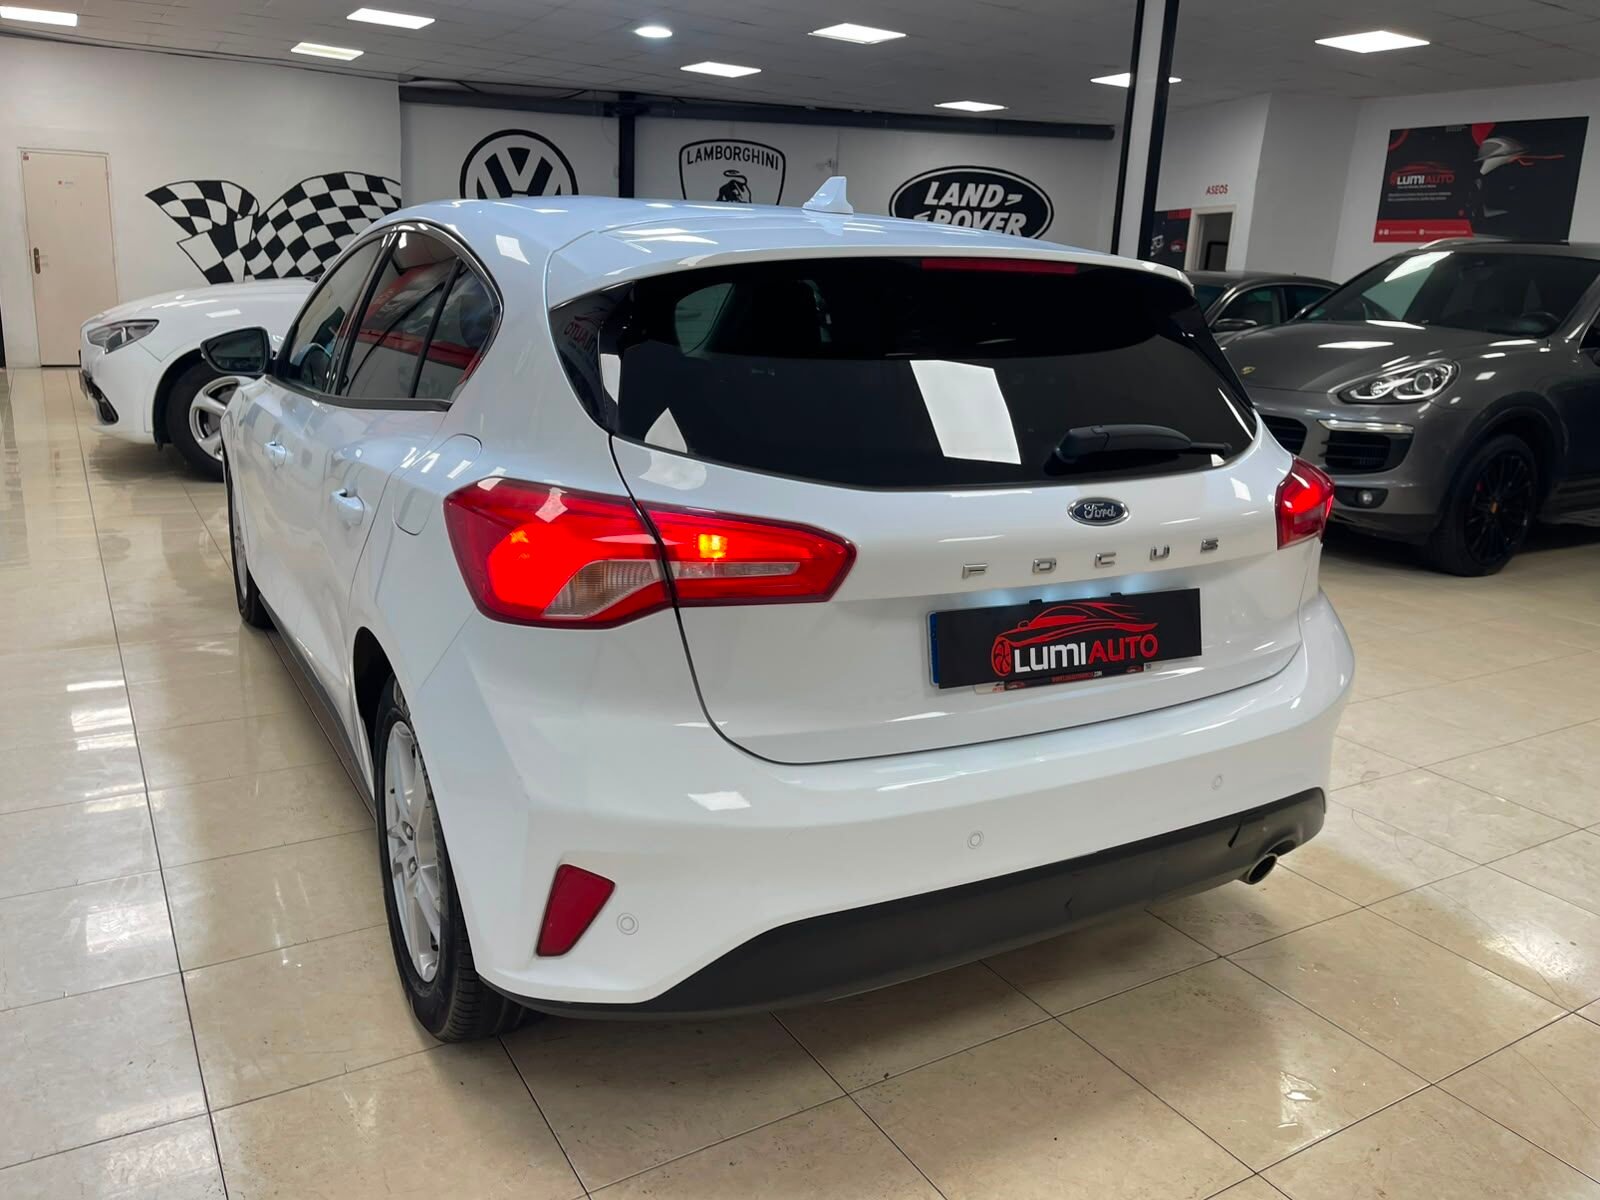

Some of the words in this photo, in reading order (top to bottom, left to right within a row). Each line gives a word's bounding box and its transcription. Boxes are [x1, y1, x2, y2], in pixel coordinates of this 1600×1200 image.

[686, 145, 779, 171] LAMBORGHINI
[923, 181, 1005, 209] LAND
[1205, 184, 1229, 195] ASEOS
[1083, 502, 1117, 519] Ford
[962, 538, 1219, 579] FOCUS
